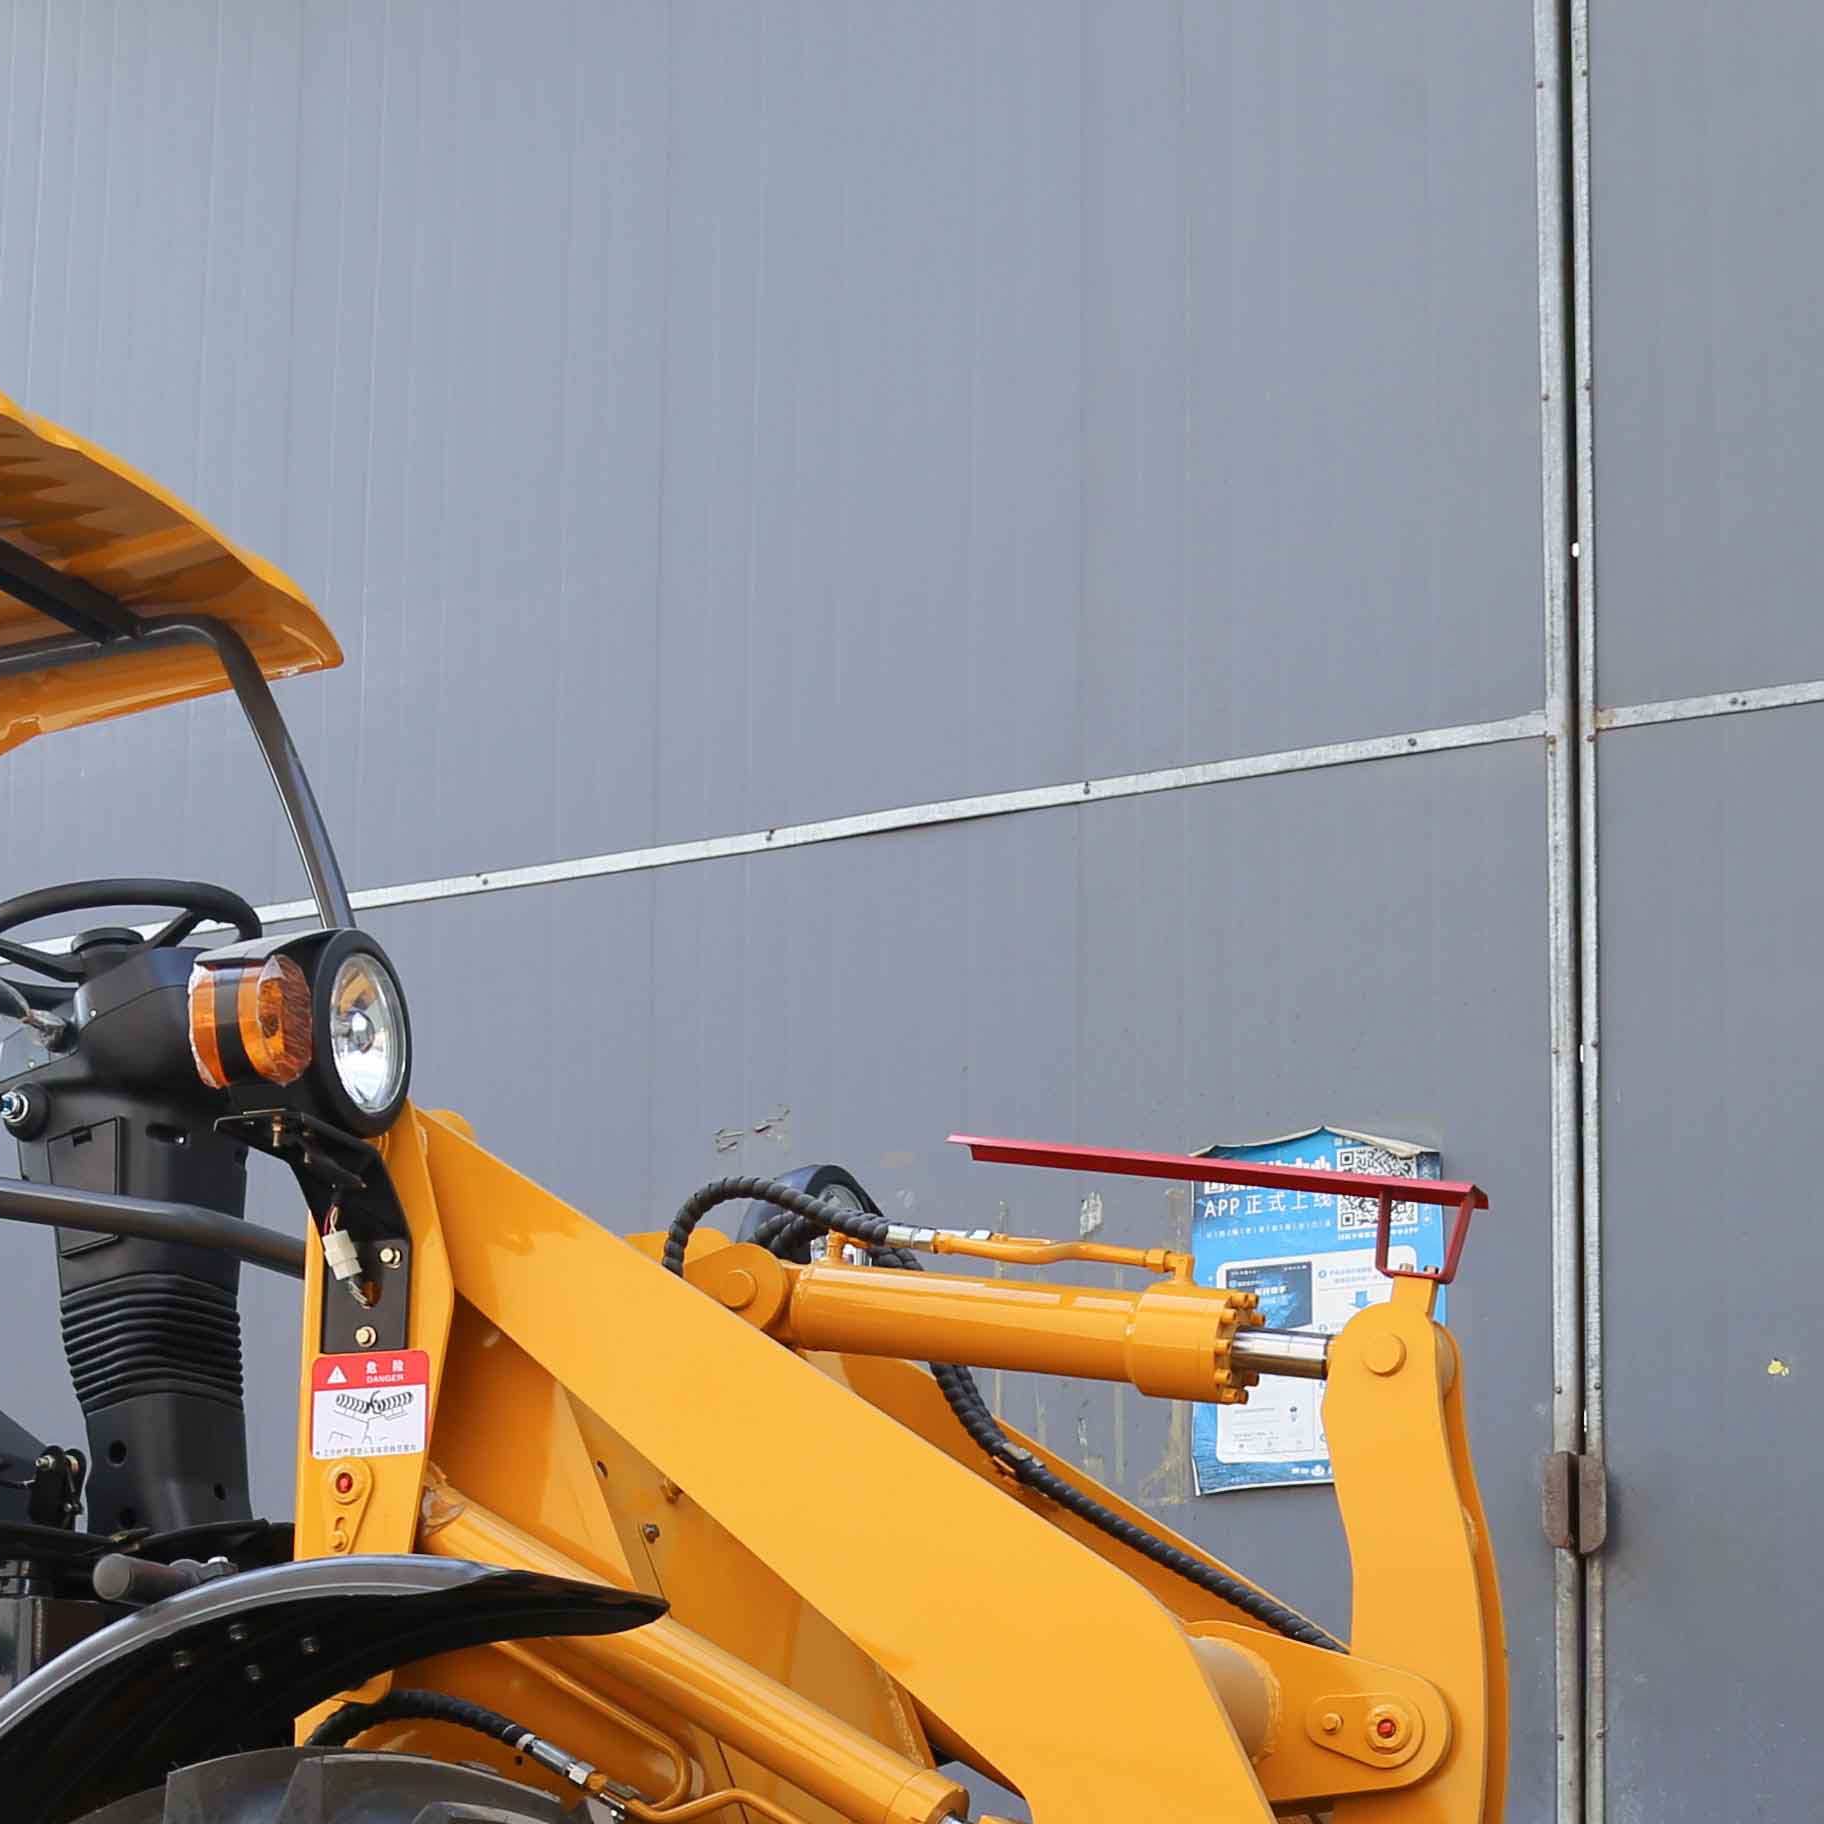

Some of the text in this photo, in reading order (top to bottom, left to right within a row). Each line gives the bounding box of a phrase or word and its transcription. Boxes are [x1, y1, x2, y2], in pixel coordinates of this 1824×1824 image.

[1204, 1191, 1332, 1217] APP 正式上线
[366, 1374, 404, 1383] DANGER
